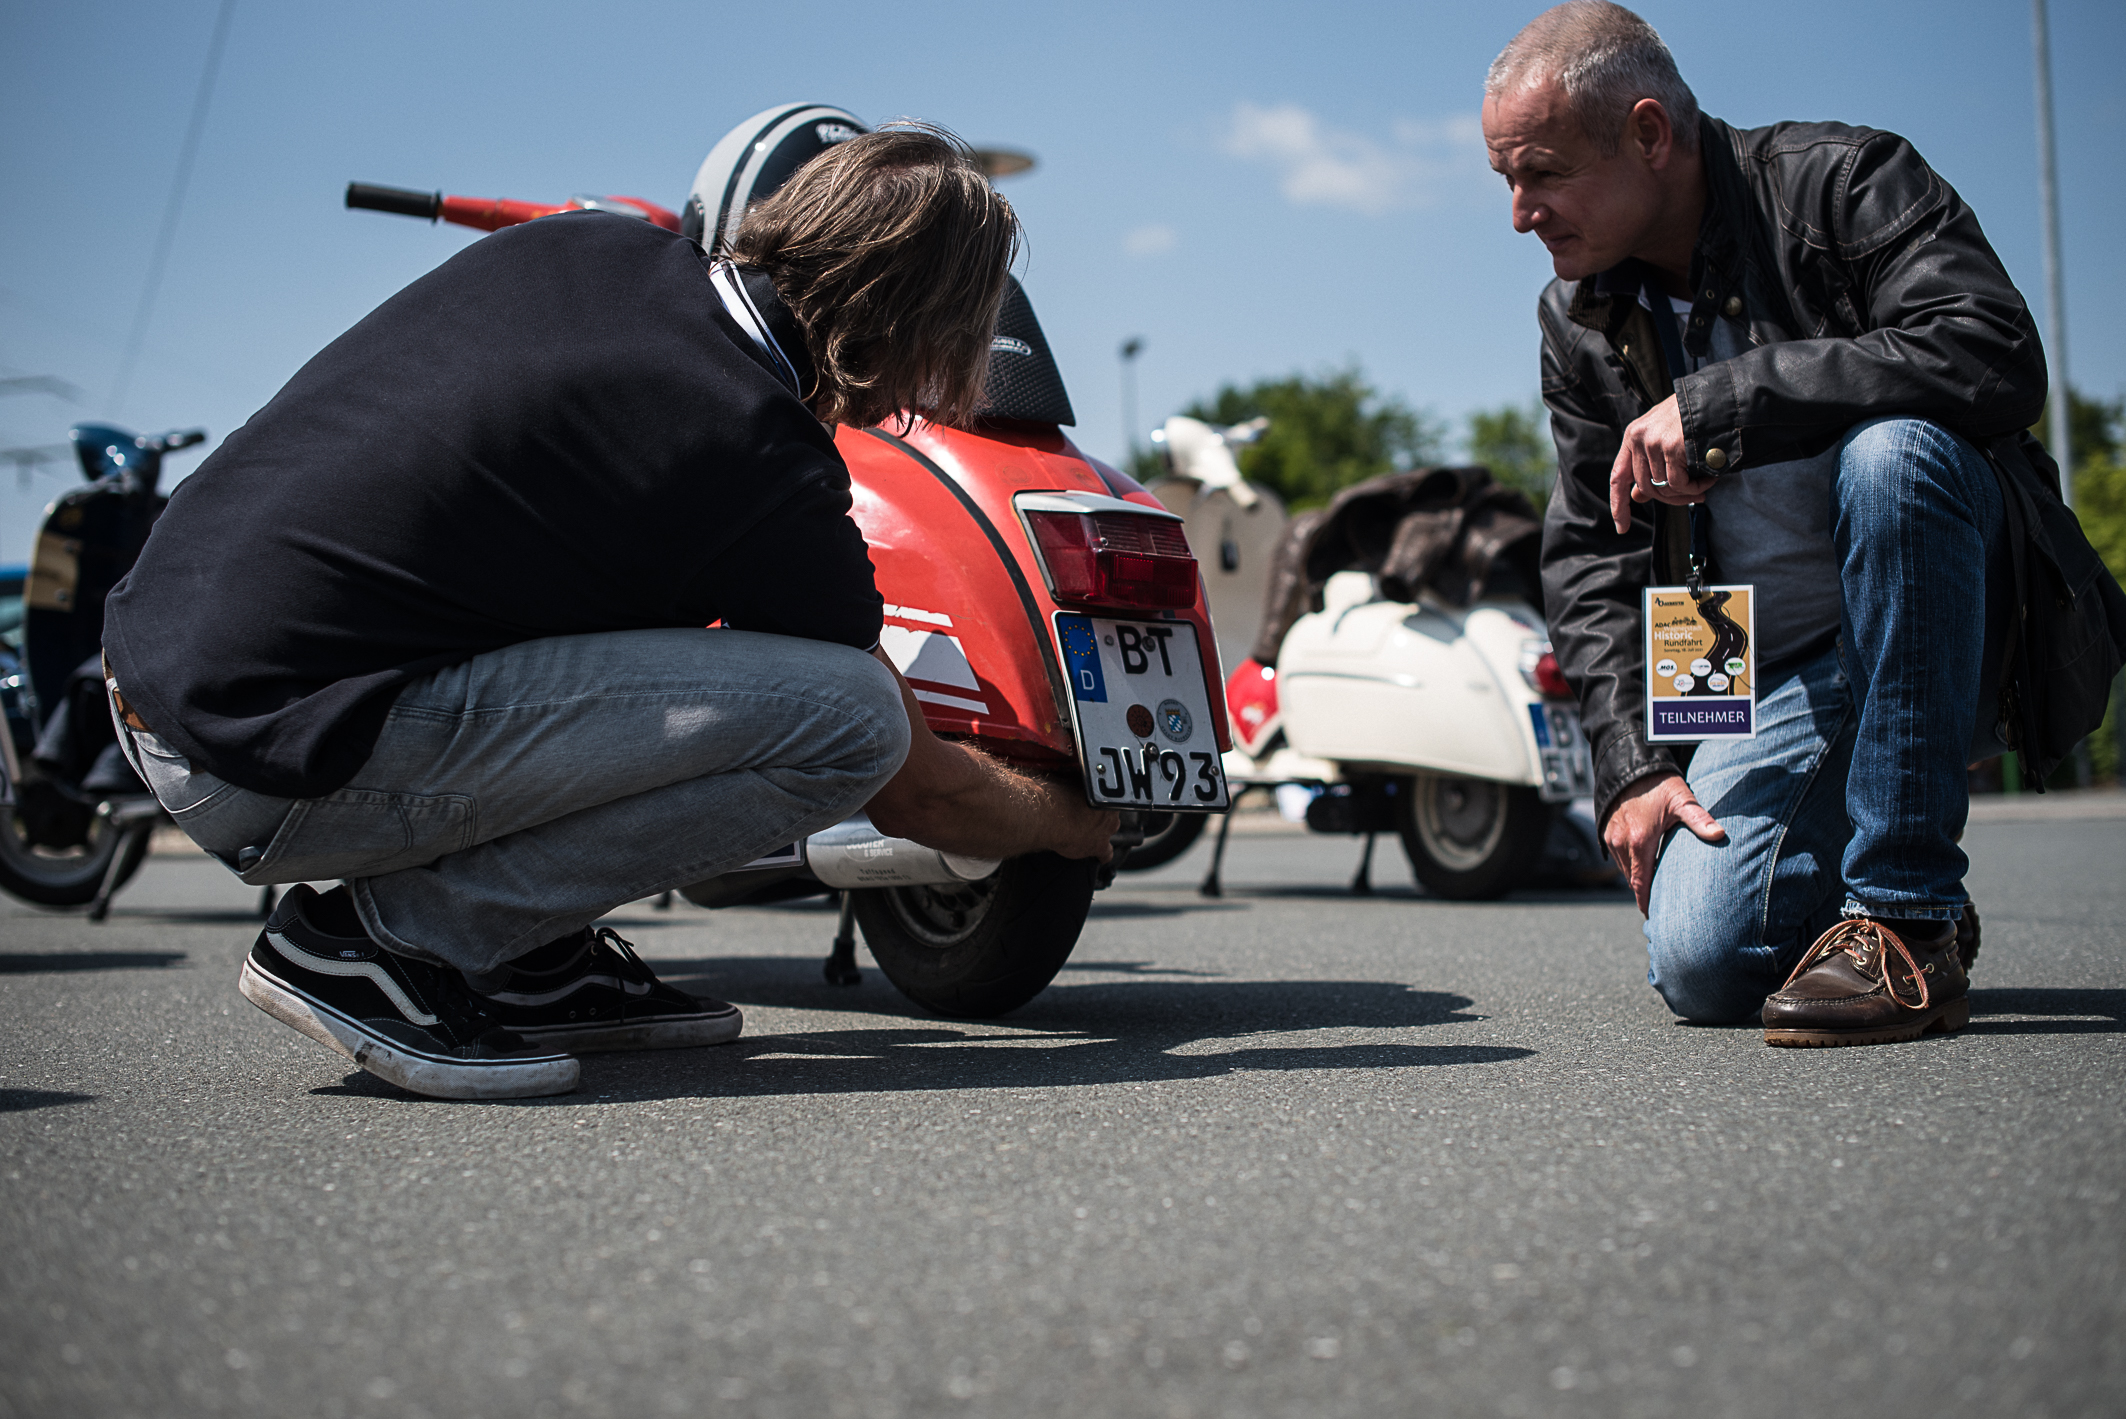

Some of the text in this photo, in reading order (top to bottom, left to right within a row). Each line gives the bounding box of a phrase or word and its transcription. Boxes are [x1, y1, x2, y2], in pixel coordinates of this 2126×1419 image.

[1654, 630, 1693, 641] Historic
[1664, 639, 1703, 647] Rundfahrt
[1115, 625, 1173, 676] BT
[1080, 669, 1095, 690] D
[1659, 711, 1745, 724] TEILNEHMER
[869, 848, 893, 857] SERVICE
